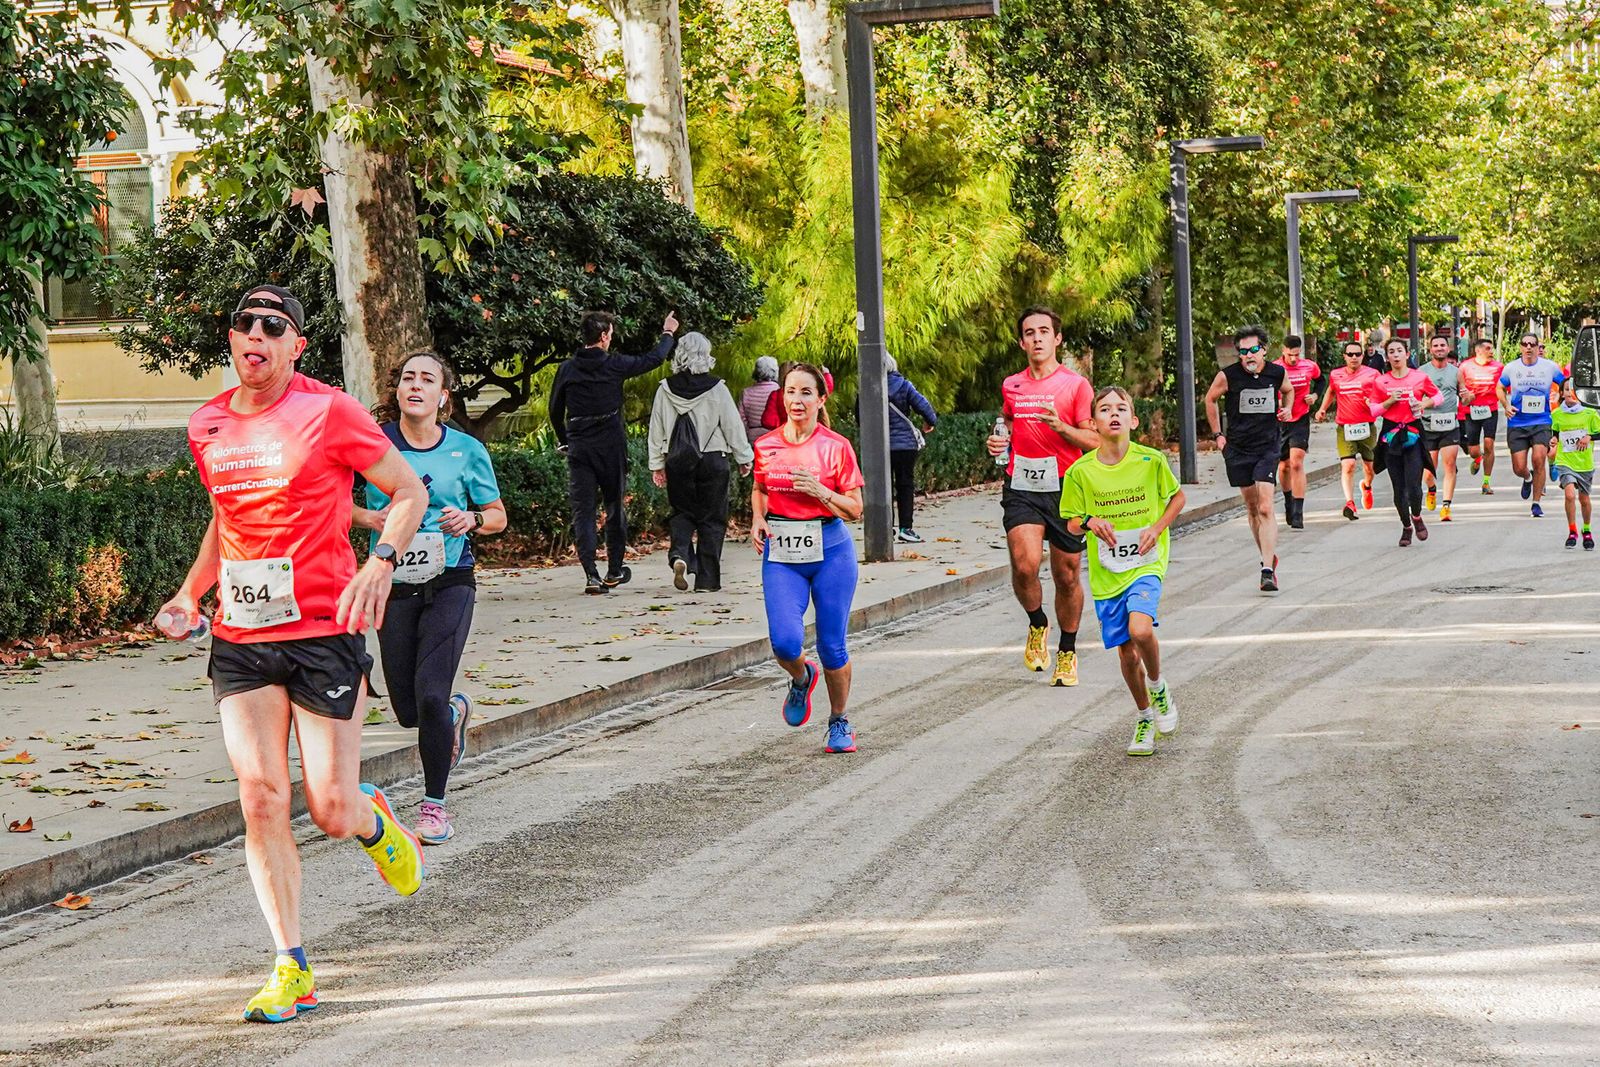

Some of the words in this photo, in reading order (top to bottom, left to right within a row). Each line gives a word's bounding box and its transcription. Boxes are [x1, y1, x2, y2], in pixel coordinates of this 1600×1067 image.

[1248, 397, 1267, 405] 637
[212, 443, 267, 459] kilómetros
[268, 440, 283, 451] de
[211, 453, 282, 475] humanidad
[1023, 468, 1046, 480] 727
[1092, 487, 1134, 498] kilómetros
[1094, 493, 1146, 507] humanidad
[776, 535, 813, 548] 1176
[1108, 543, 1140, 558] 152
[231, 584, 272, 604] 264
